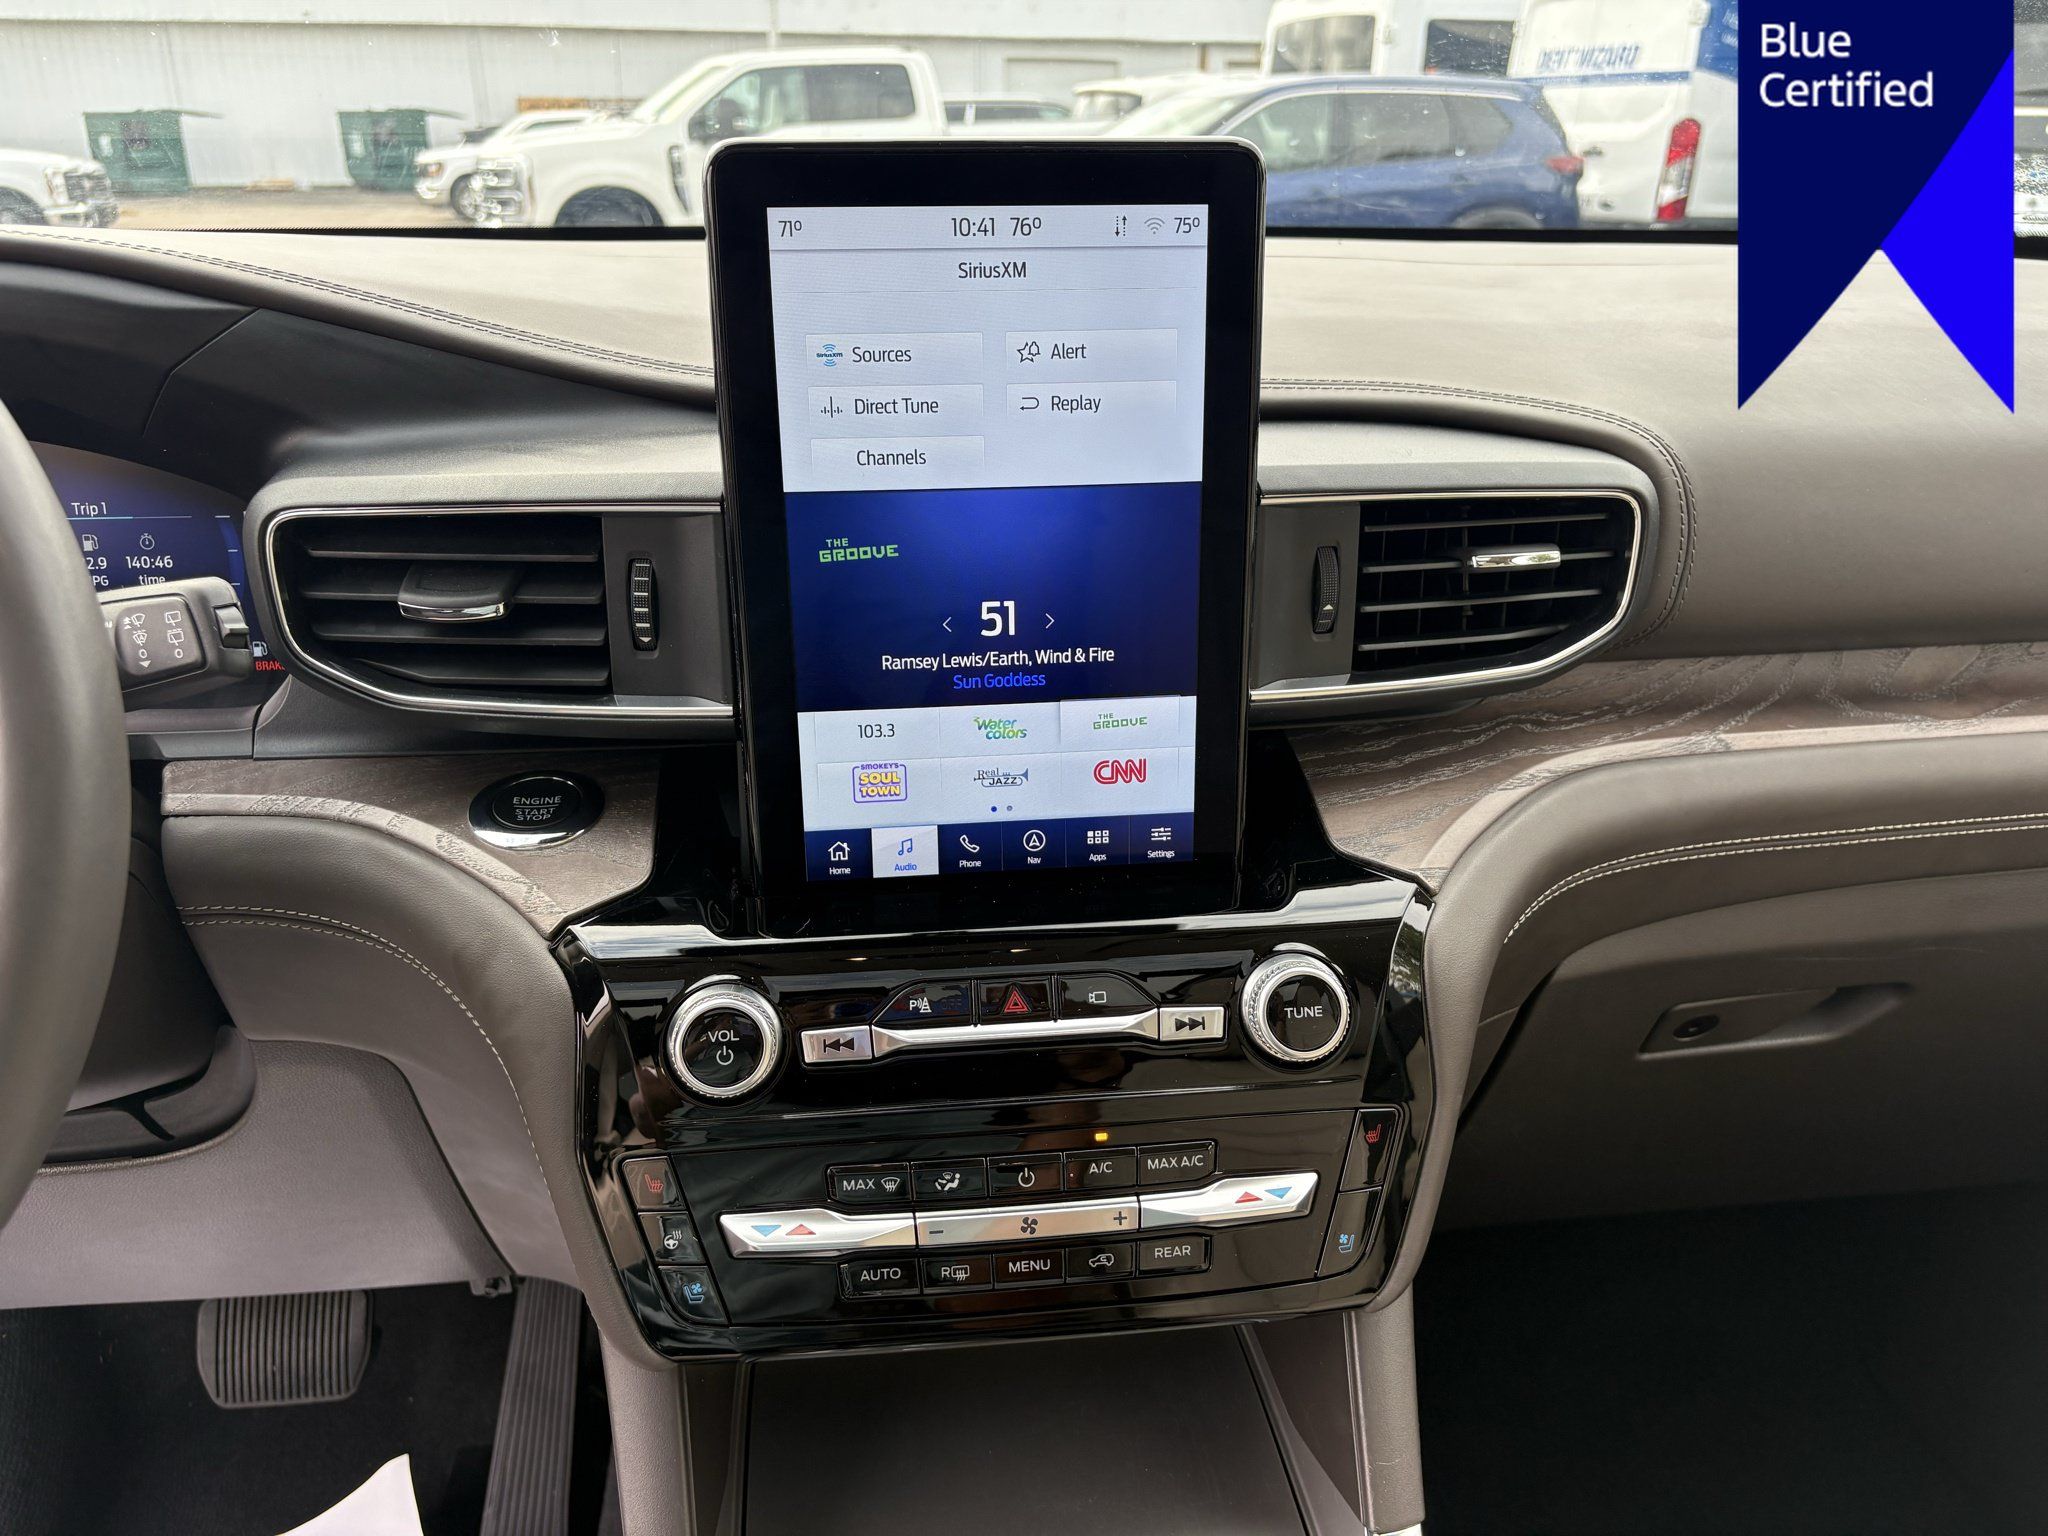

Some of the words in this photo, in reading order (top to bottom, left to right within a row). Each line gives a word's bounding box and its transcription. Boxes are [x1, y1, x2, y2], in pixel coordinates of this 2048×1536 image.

[951, 216, 996, 238] 10:41
[957, 260, 1027, 280] SiriusXM
[852, 345, 912, 363] Sources
[1050, 342, 1087, 360] Alert
[854, 397, 899, 415] Direct
[901, 397, 939, 415] Tune
[1051, 394, 1101, 416] Replay
[856, 449, 927, 467] Channels
[71, 502, 98, 517] Trip
[101, 501, 107, 514] 1
[826, 537, 849, 548] THE
[819, 544, 899, 563] GROOVE
[126, 555, 174, 569] 140:46
[138, 573, 166, 586] time
[980, 600, 1017, 637] 51
[255, 660, 285, 672] BRAK
[881, 652, 940, 673] Ramsey
[942, 649, 1032, 669] Lewis/Earth,
[1035, 647, 1072, 666] Wind
[1075, 647, 1086, 664] &
[1088, 646, 1115, 663] Fire
[953, 673, 982, 690] Sun
[984, 671, 1047, 689] Goddess
[1093, 716, 1148, 730] GROOVE
[1098, 712, 1114, 720] THE
[974, 717, 1018, 731] Water
[857, 723, 896, 740] 103.3
[985, 727, 1028, 740] colors
[859, 771, 900, 786] SOUL
[977, 767, 1000, 780] Real
[1093, 758, 1147, 785] CNN
[988, 776, 1018, 786] JAZZ
[860, 784, 900, 798] TOWN
[513, 795, 562, 805] ENGINE
[515, 807, 556, 815] START
[516, 813, 551, 821] STOP
[1027, 856, 1042, 865] Nav
[1088, 853, 1107, 862] Apps
[1147, 849, 1175, 860] Settings
[894, 862, 918, 872] Audio
[959, 859, 982, 868] Phone
[829, 866, 851, 876] Home
[1284, 1005, 1323, 1019] TUNE
[708, 1030, 740, 1043] VOL
[1088, 1160, 1113, 1175] A/C
[1147, 1156, 1178, 1170] MAX
[1181, 1153, 1204, 1168] A/C
[843, 1176, 876, 1192] MAX
[1153, 1245, 1191, 1259] REAR
[1008, 1259, 1051, 1274] MENU
[860, 1267, 901, 1283] AUTO
